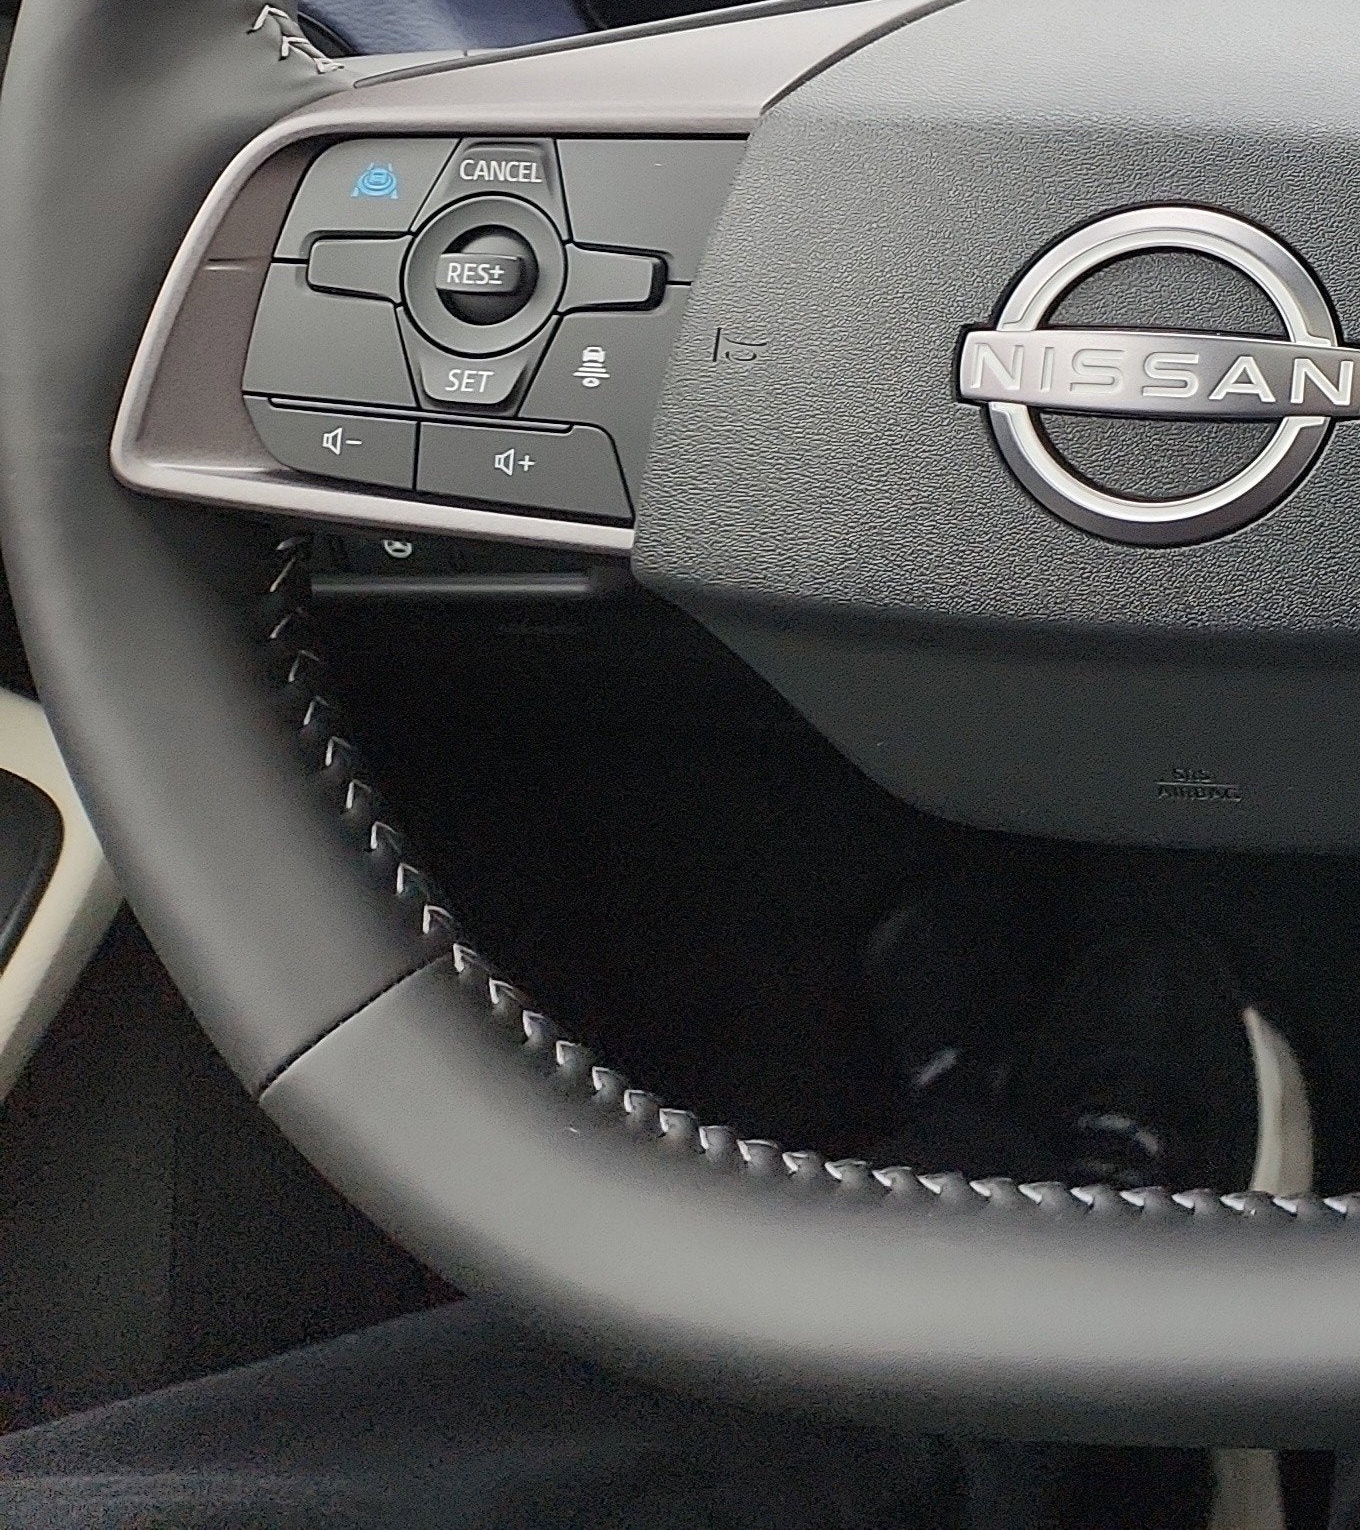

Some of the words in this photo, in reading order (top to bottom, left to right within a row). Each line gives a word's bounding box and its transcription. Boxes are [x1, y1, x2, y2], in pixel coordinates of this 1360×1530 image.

[459, 159, 543, 185] CANCEL
[445, 369, 495, 394] SET
[971, 342, 1354, 407] NISSAN
